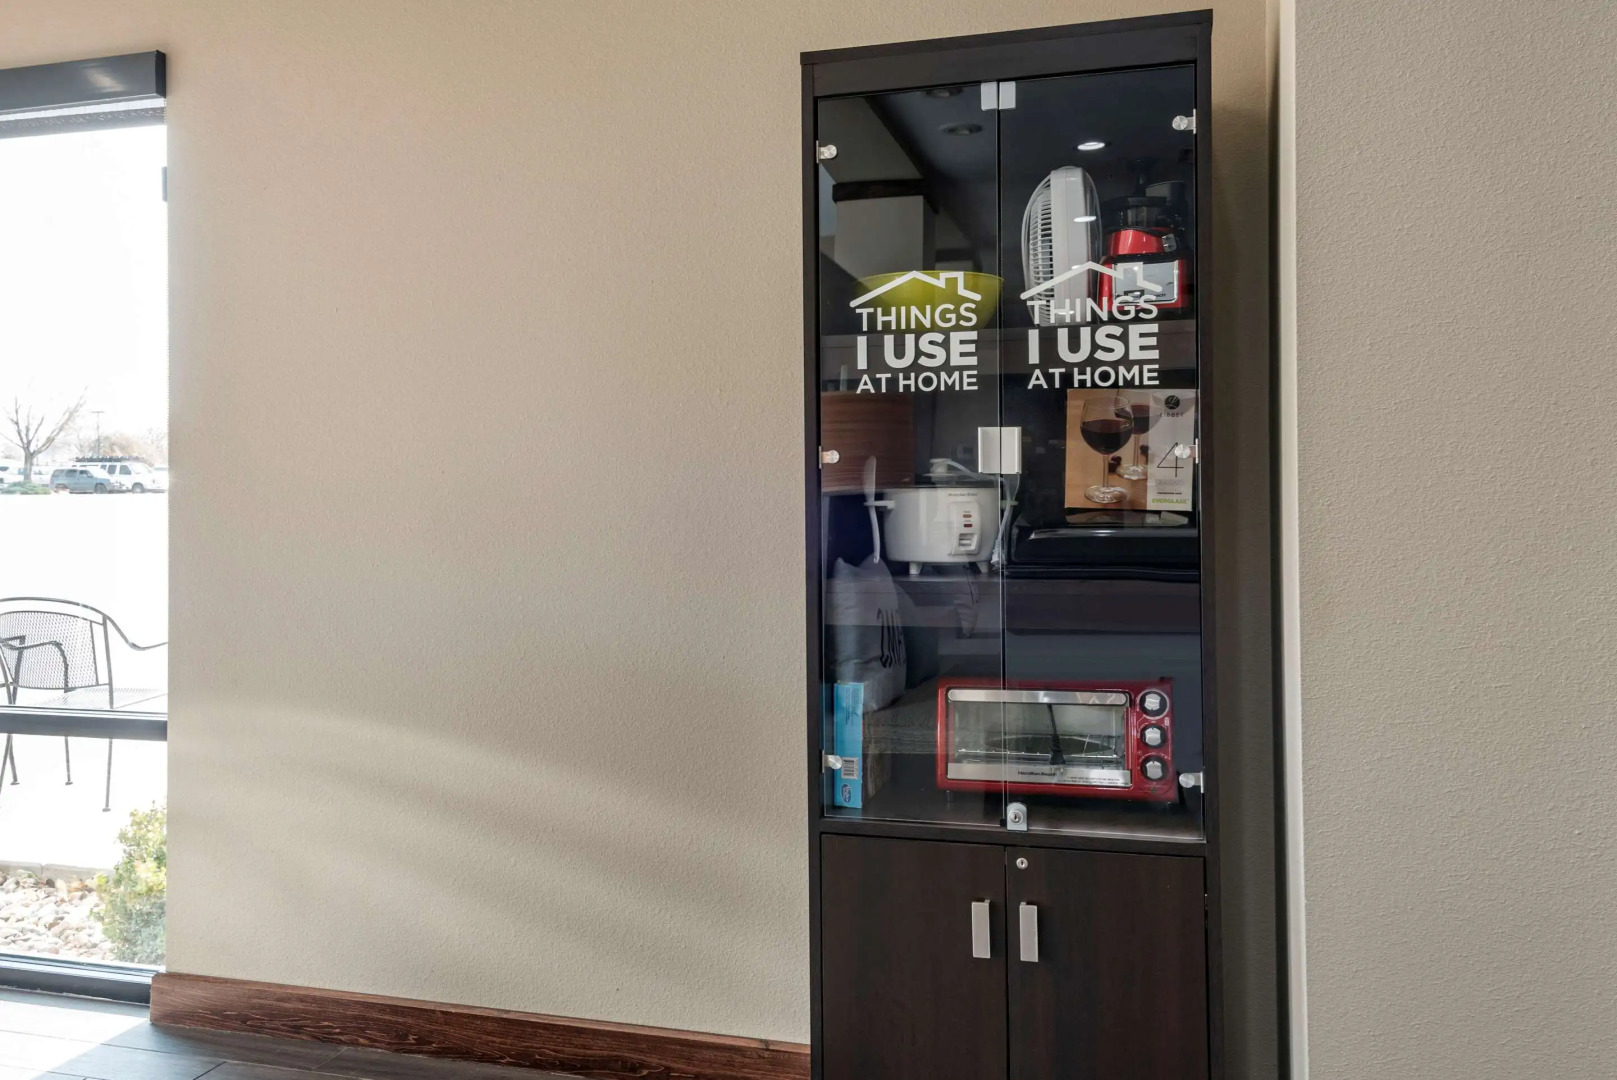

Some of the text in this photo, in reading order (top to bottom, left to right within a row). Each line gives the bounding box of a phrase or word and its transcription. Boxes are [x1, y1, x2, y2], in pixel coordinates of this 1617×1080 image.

[855, 303, 977, 331] THINGS
[1027, 295, 1158, 325] THINGS
[857, 331, 978, 370] I USE
[1028, 324, 1160, 364] I USE
[856, 370, 979, 394] AT HOME
[1027, 364, 1160, 389] AT HOME
[1157, 442, 1184, 477] 4
